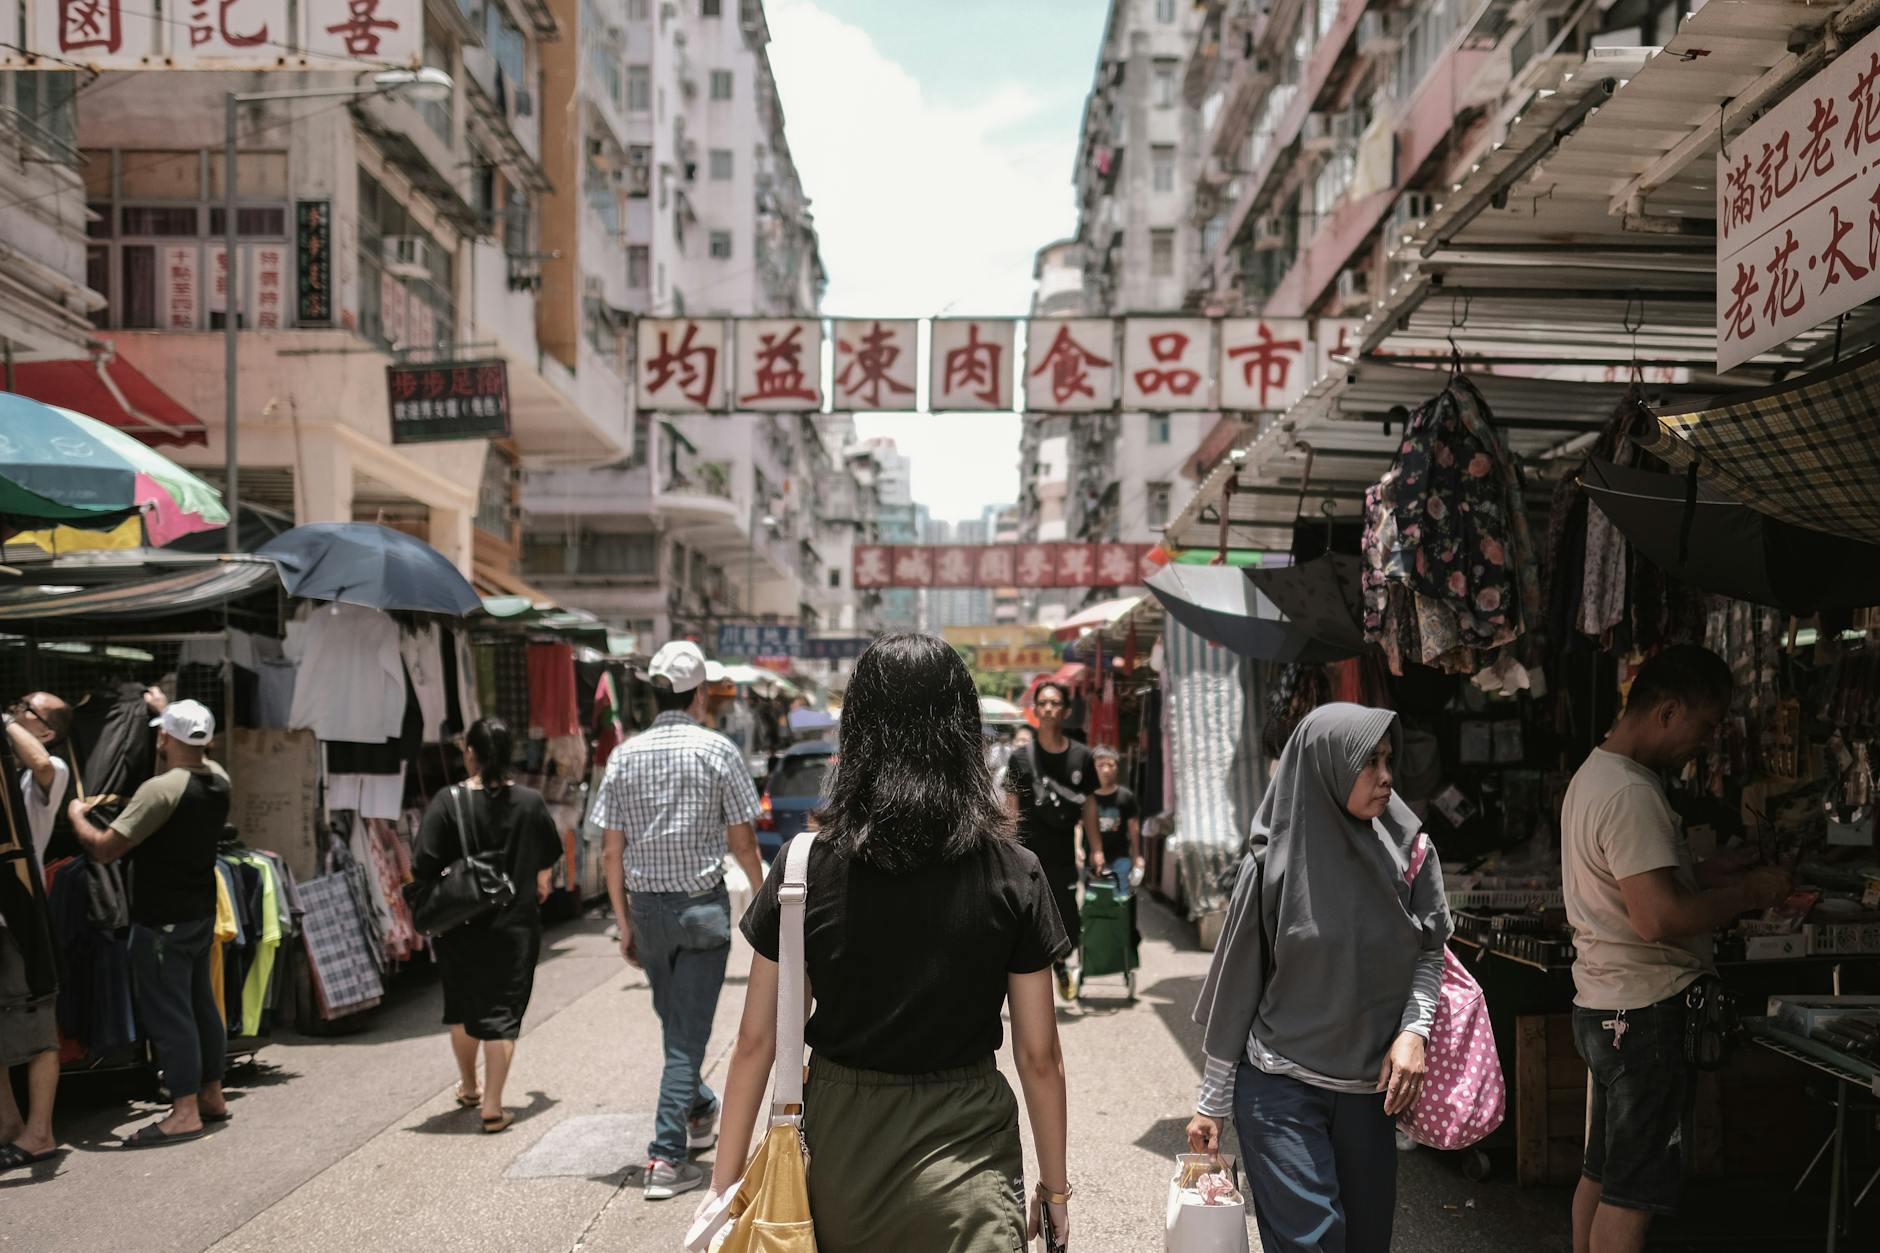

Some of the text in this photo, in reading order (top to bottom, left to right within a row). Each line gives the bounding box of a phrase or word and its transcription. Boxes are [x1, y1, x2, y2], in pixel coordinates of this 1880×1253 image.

[1722, 52, 1880, 239] 滿記老花
[170, 250, 193, 329] 十點至四點
[259, 251, 280, 329] 特價時段
[1723, 183, 1880, 343] 老花·太
